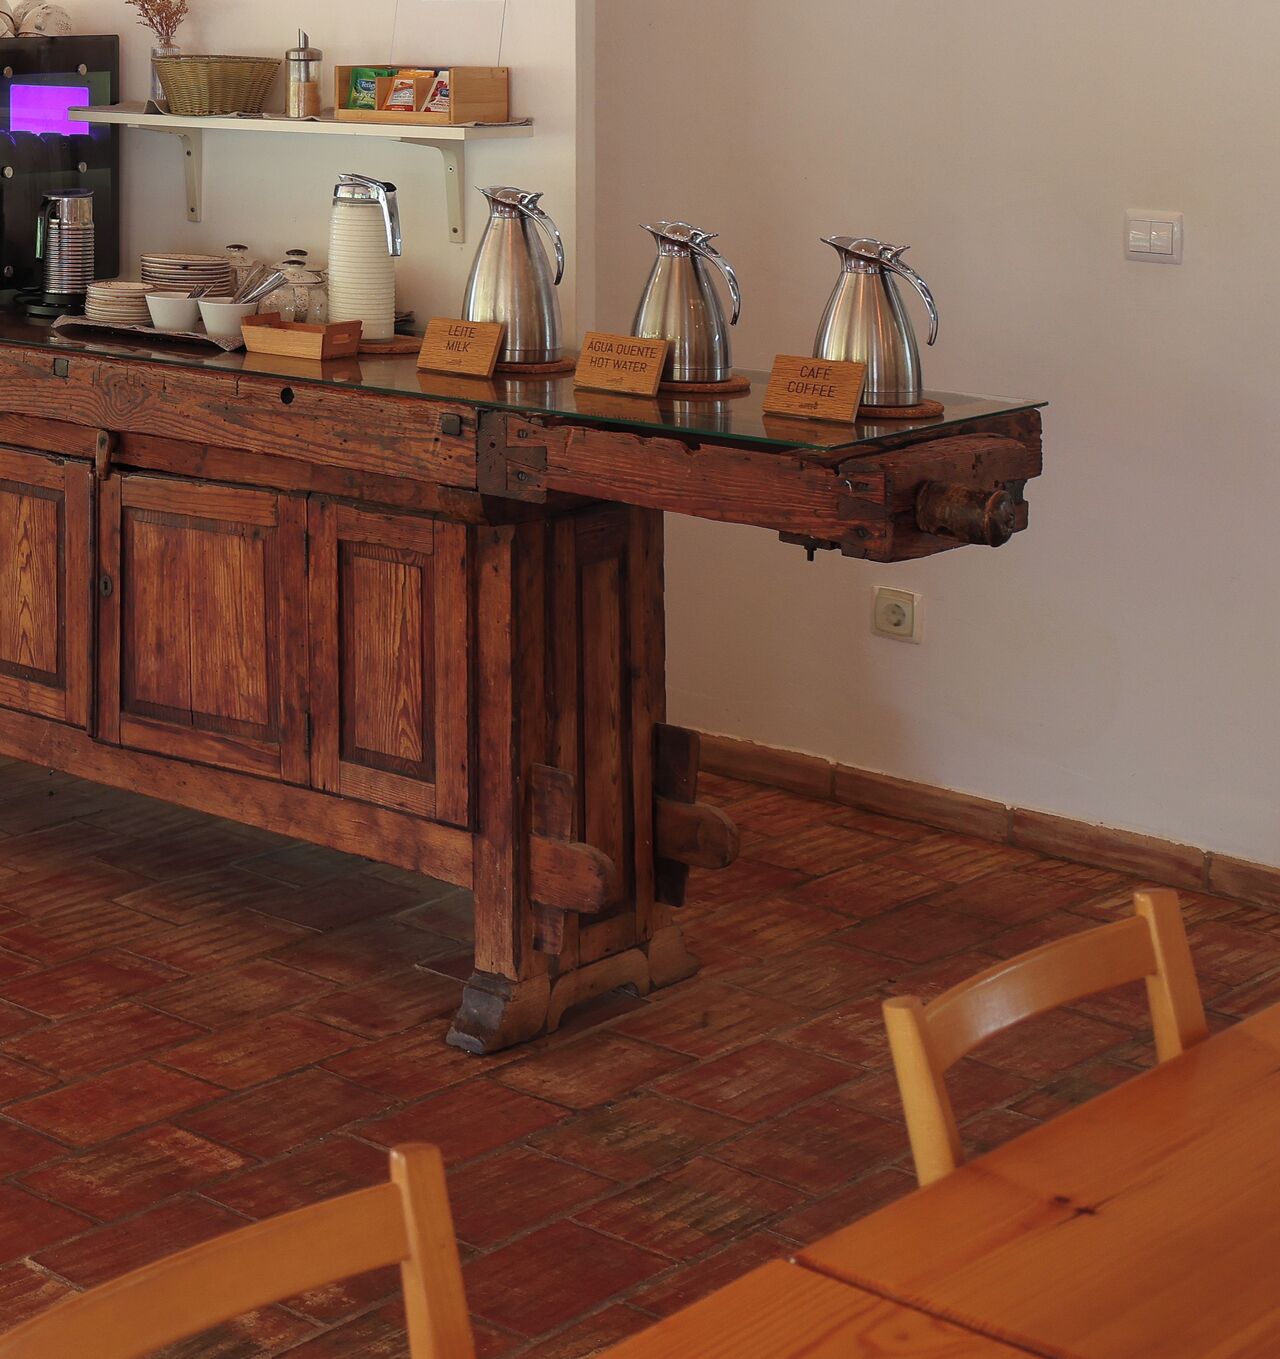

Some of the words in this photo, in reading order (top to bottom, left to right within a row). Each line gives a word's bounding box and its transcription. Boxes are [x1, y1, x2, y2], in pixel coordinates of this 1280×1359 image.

[448, 325, 477, 339] LEITE
[445, 340, 471, 353] MILK
[616, 343, 658, 359] QUENTE
[589, 356, 611, 368] HOT
[613, 359, 648, 373] WATER
[800, 365, 833, 381] CAFÉ
[786, 380, 837, 398] COFFEE
